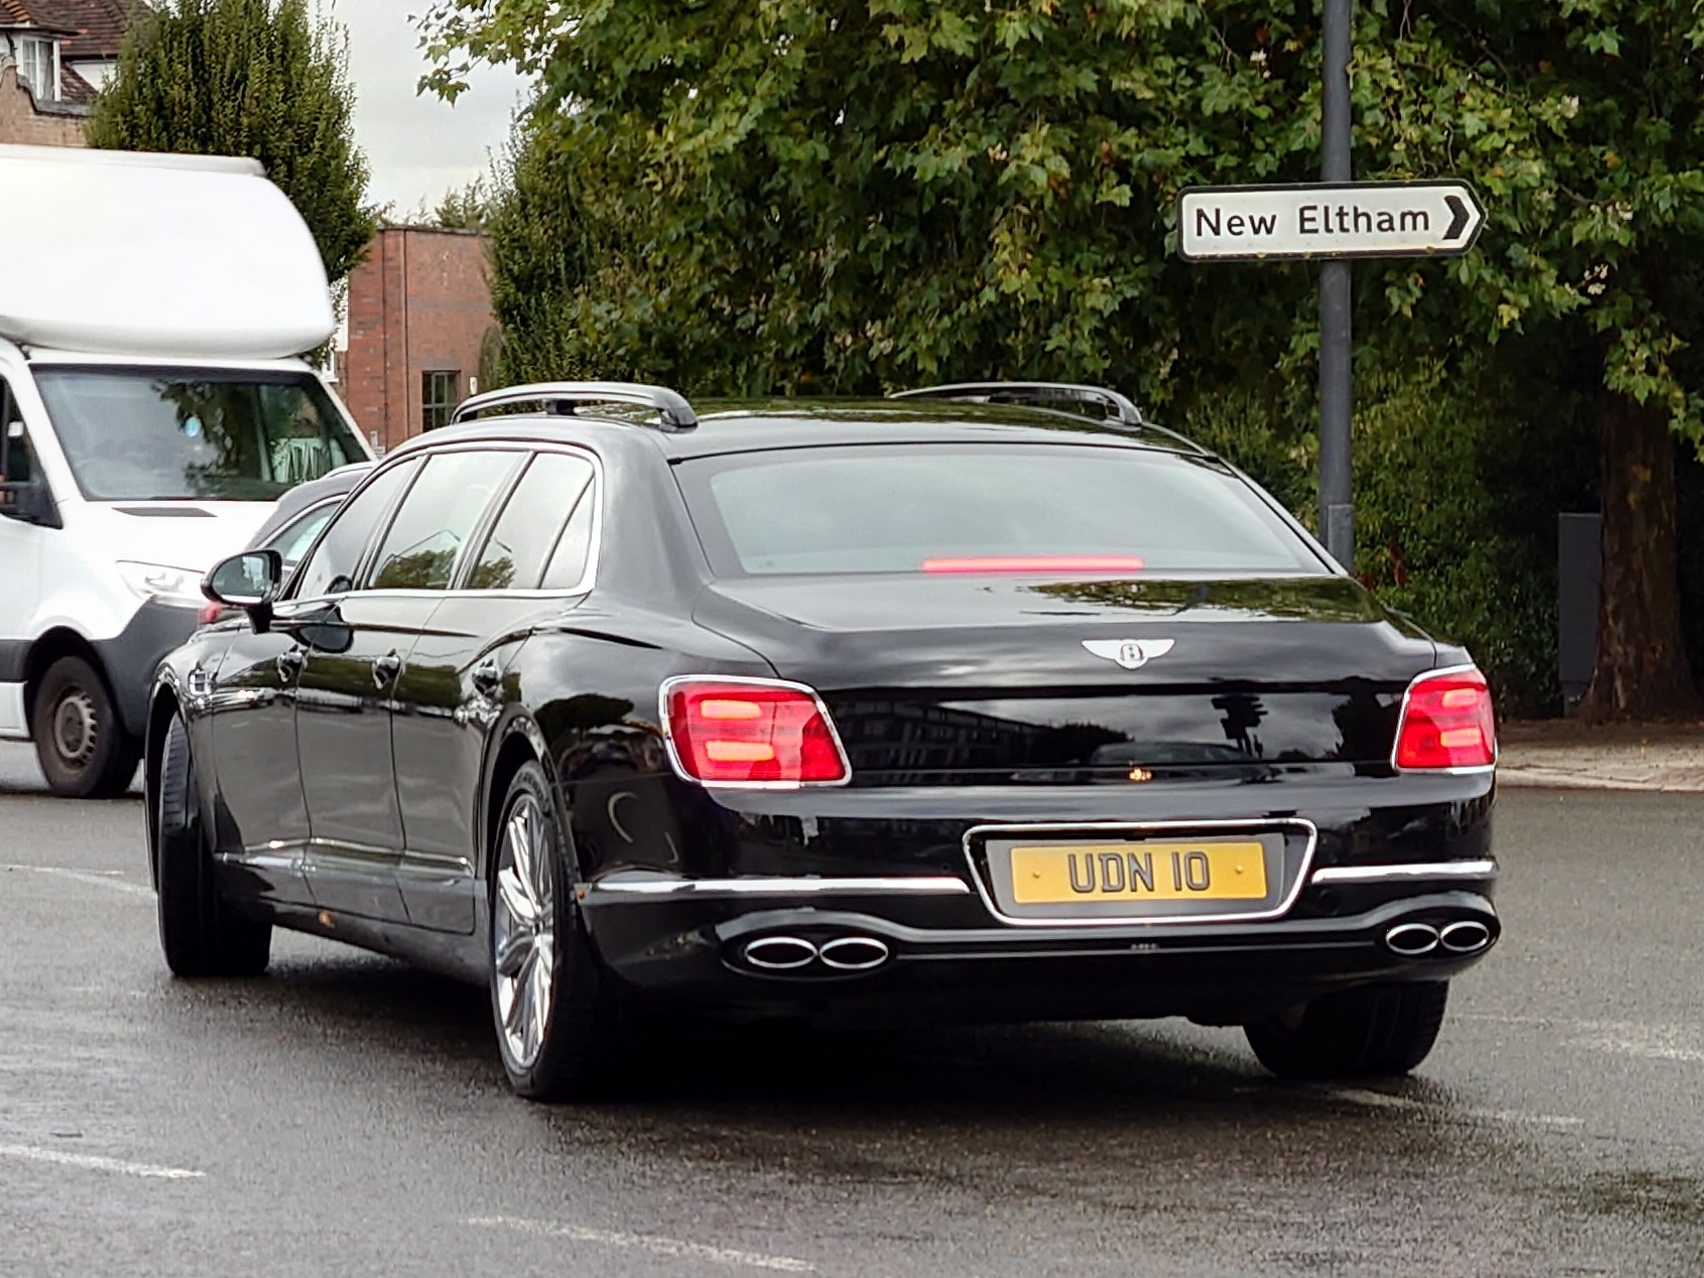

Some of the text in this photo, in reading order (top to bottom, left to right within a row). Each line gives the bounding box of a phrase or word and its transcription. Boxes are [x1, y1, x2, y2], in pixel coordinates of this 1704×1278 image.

[1196, 205, 1429, 236] New Eltham
[1068, 851, 1210, 893] UDN 10
